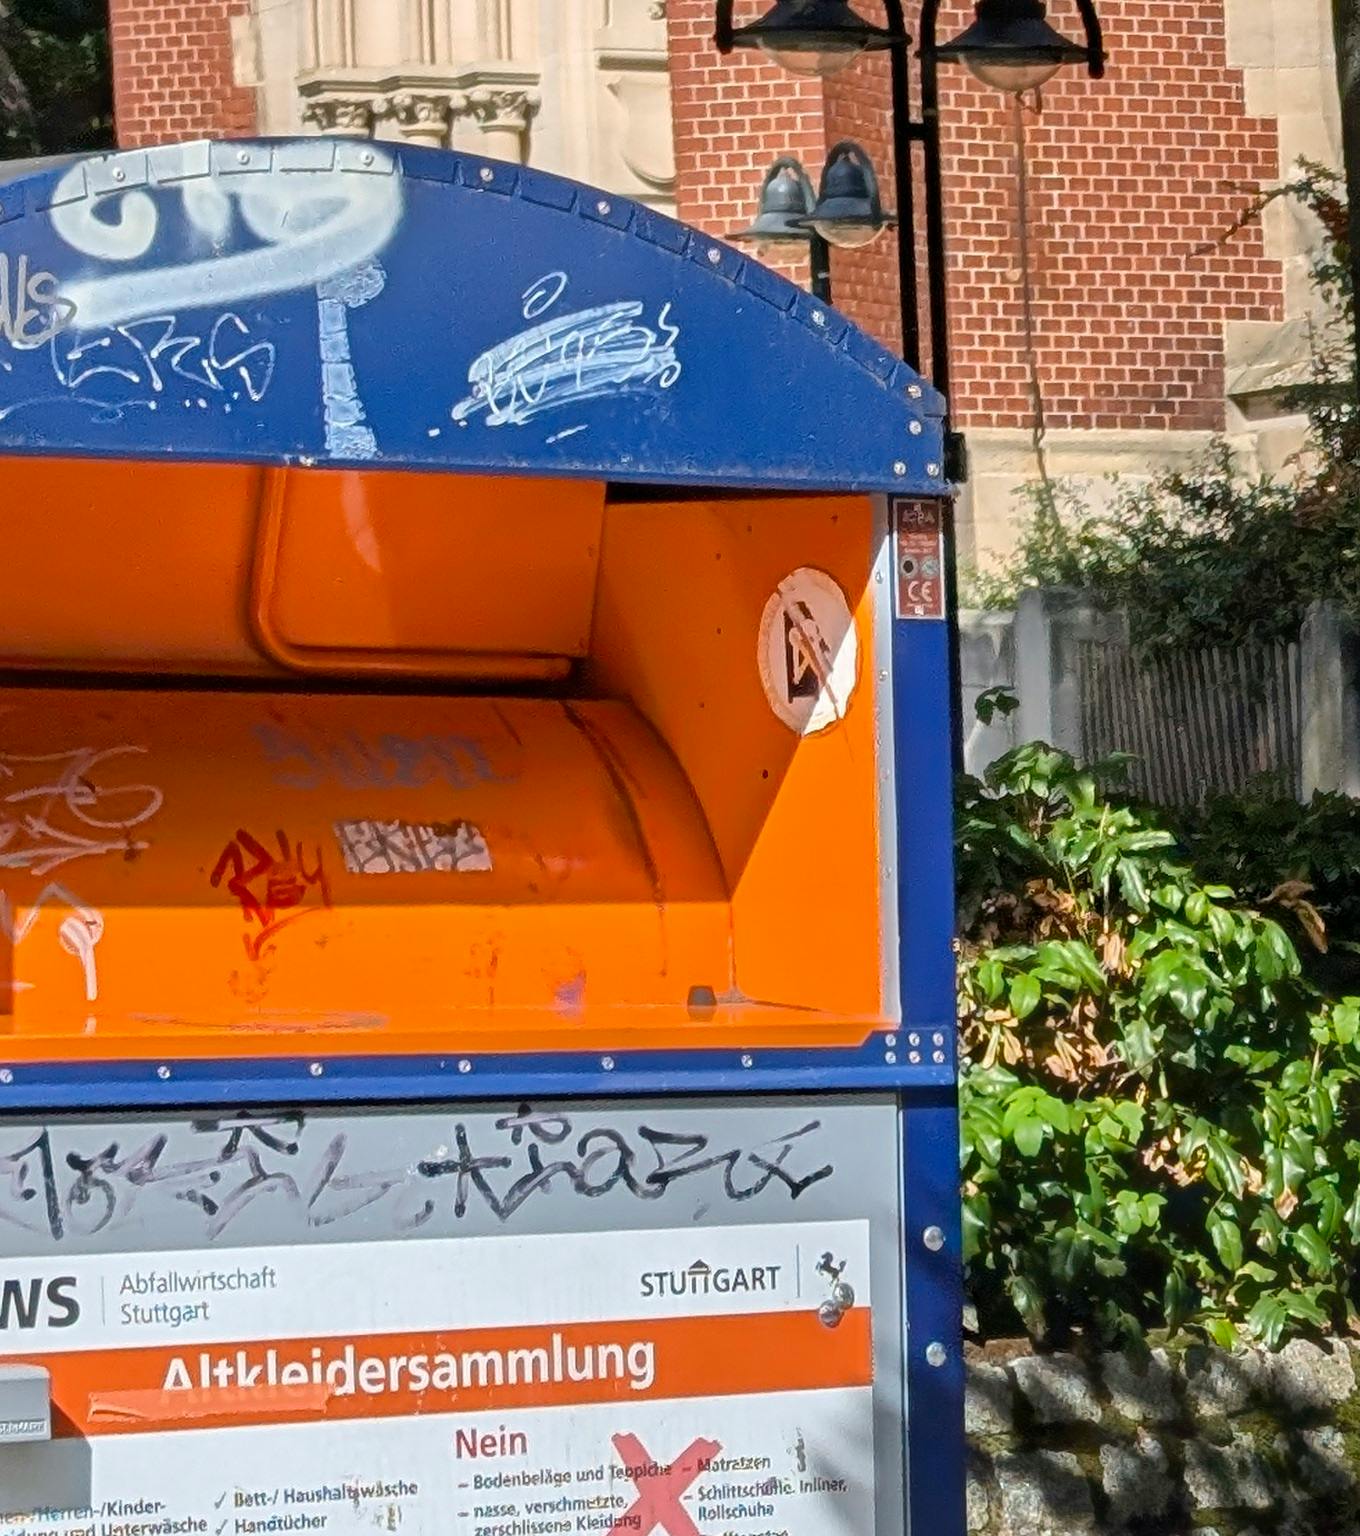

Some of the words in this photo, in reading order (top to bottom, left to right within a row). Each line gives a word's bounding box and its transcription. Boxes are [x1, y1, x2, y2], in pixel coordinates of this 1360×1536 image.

[120, 1265, 277, 1295] Abfallwirtschaft
[641, 1259, 781, 1297] STUTTGART
[120, 1301, 210, 1328] Stuttgart
[163, 1334, 655, 1391] Altkleidersammlung
[455, 1425, 528, 1459] Nein
[473, 1468, 571, 1490] Bodenbeläge
[576, 1466, 604, 1482] und
[609, 1462, 672, 1482] Teppiche
[697, 1456, 771, 1473] Matratzen
[474, 1503, 520, 1518] nasse,
[525, 1494, 628, 1513] verschmutzte,
[698, 1502, 775, 1521] Rollschuhe
[235, 1514, 328, 1534] Handtücher
[576, 1513, 642, 1531] Kleidung
